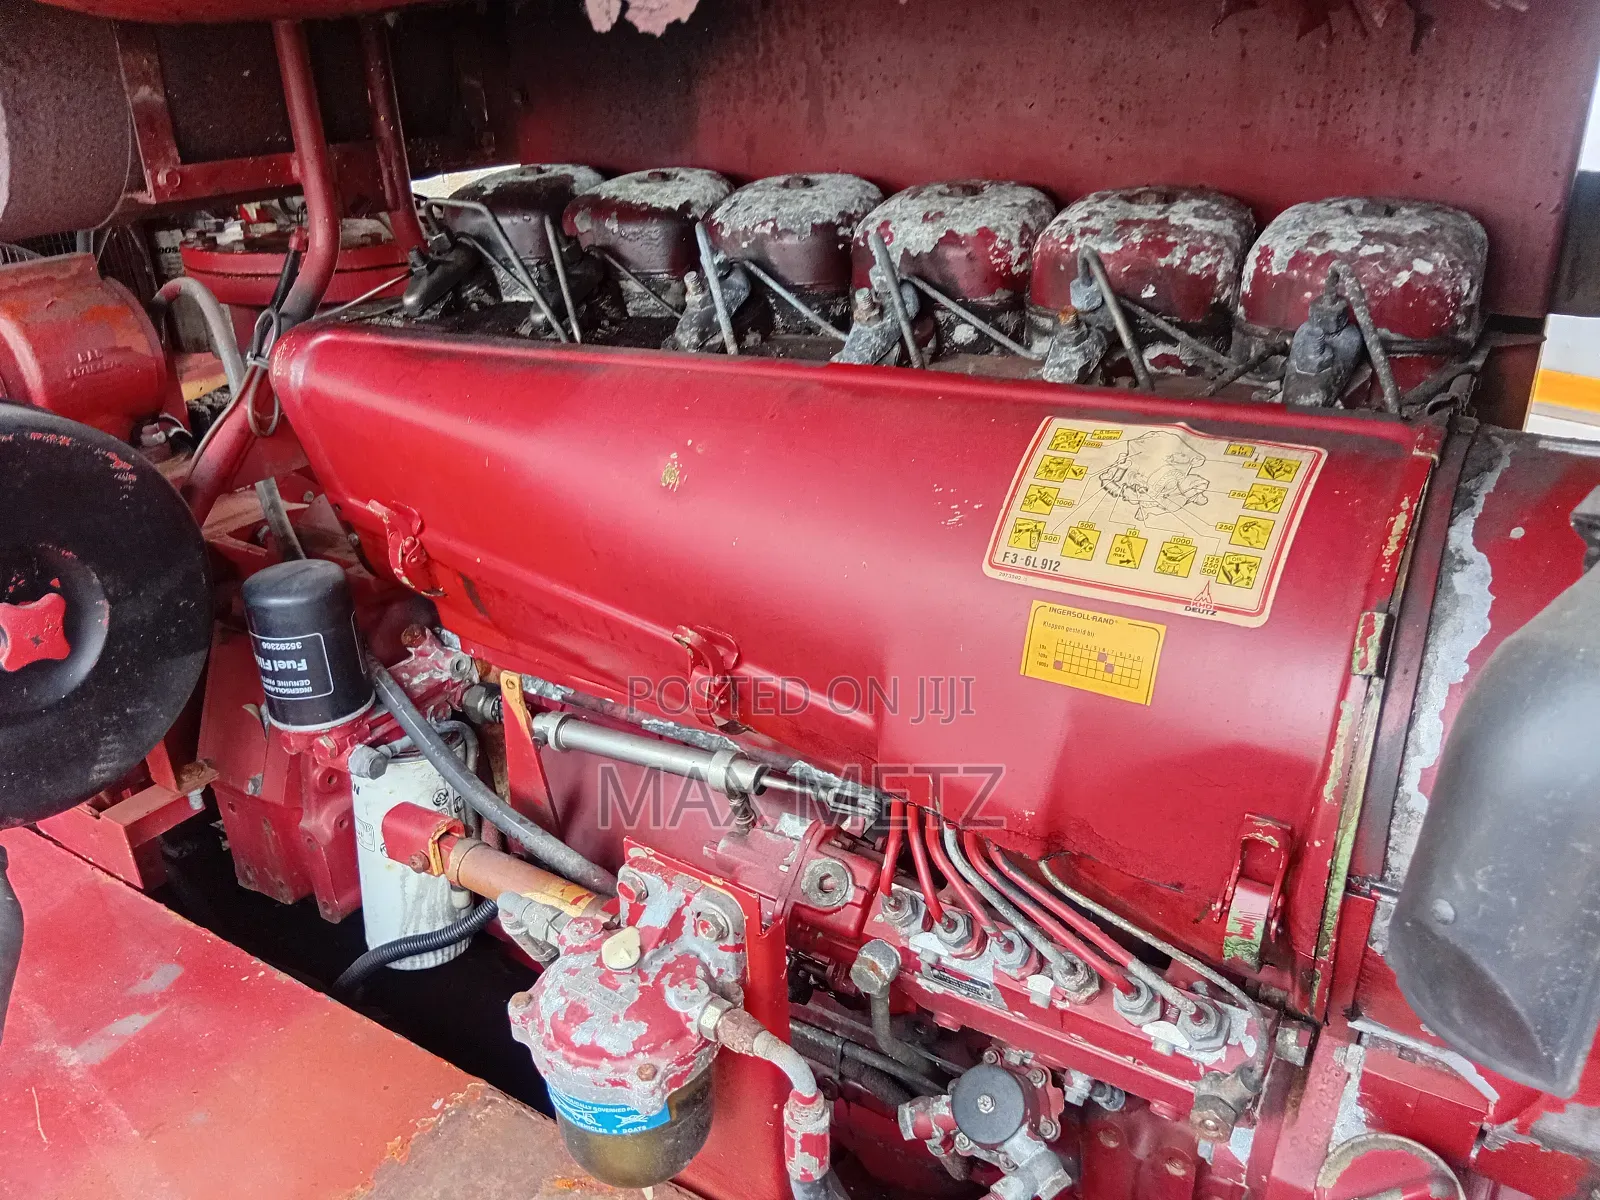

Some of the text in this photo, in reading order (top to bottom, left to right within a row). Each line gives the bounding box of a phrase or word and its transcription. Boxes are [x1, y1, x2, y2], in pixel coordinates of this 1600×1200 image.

[1172, 538, 1191, 546] 1000
[1040, 558, 1061, 572] 912
[1184, 605, 1218, 616] DEUTZ
[1191, 601, 1212, 610] KHD
[1048, 606, 1115, 626] INGERSOLL-RAND
[274, 658, 308, 672] Fuel
[277, 679, 311, 687] GENUINE
[577, 1121, 608, 1134] VEHICLES
[622, 1125, 647, 1134] BOATS
